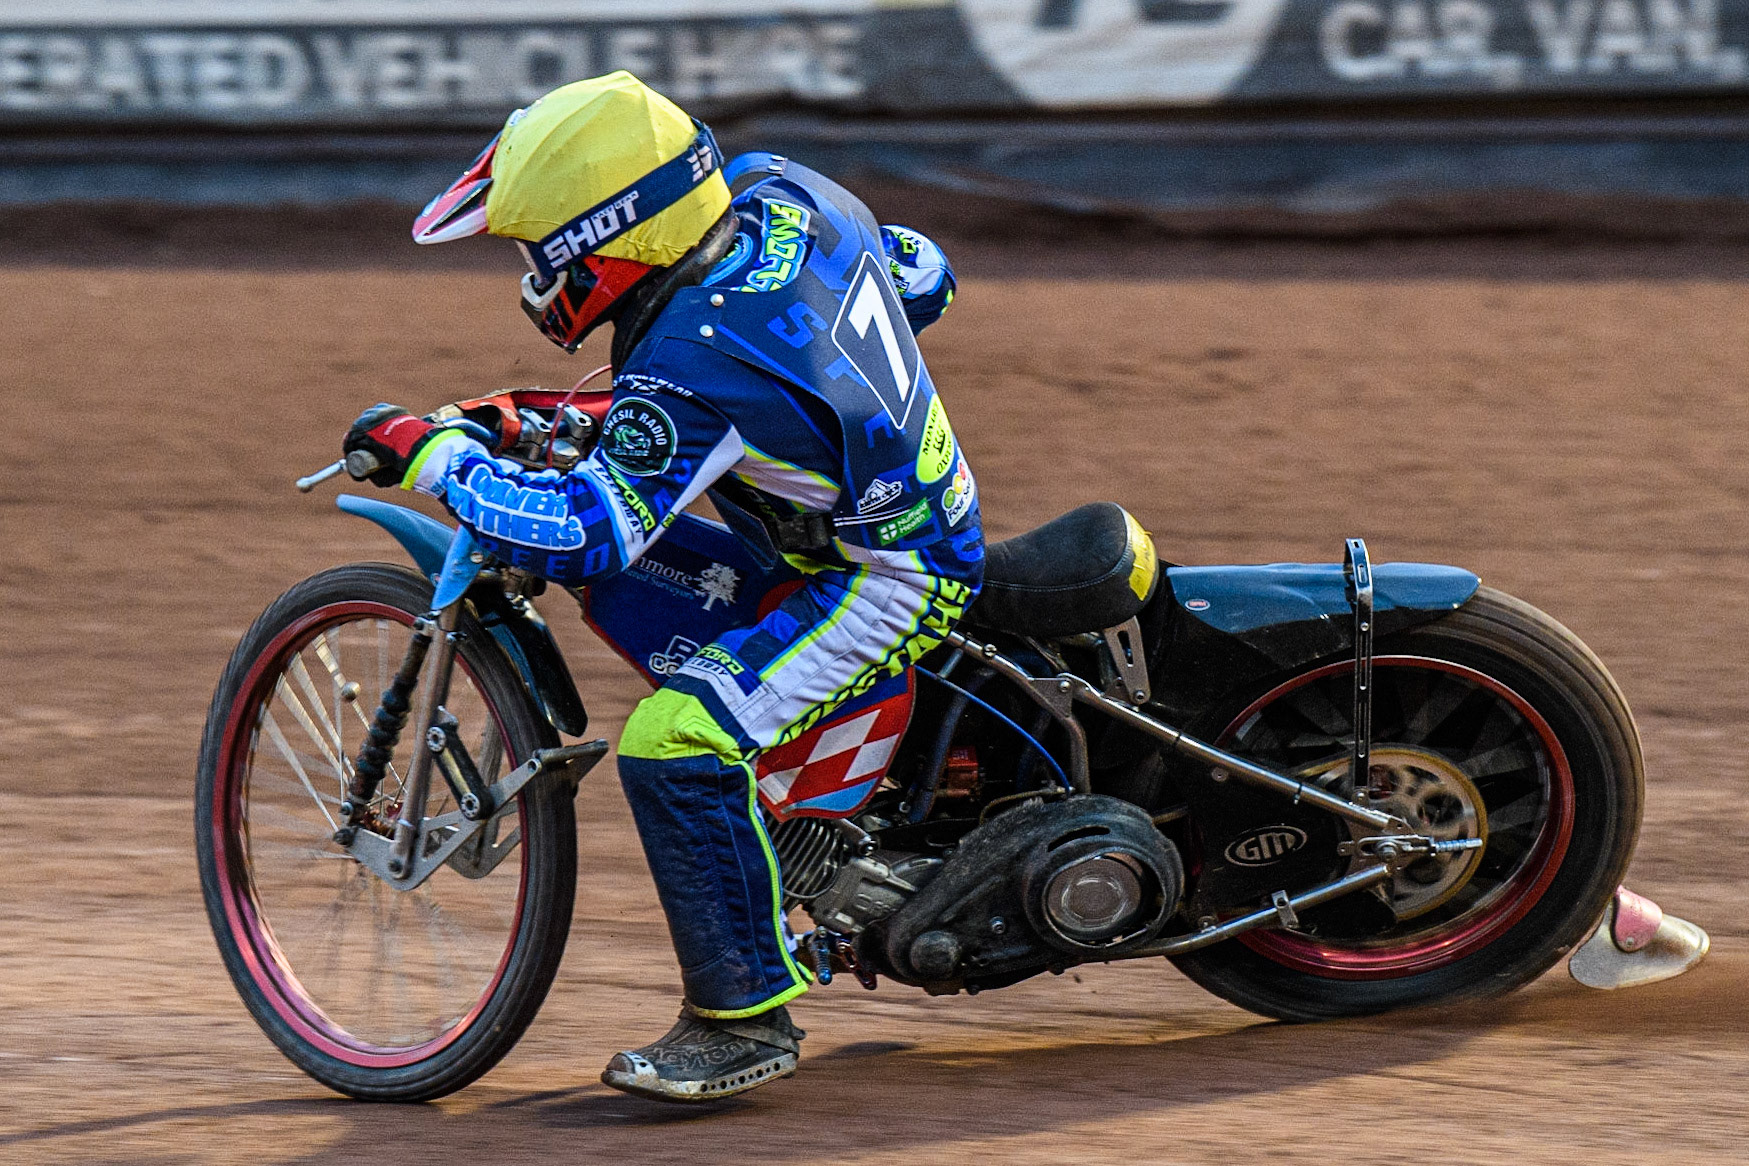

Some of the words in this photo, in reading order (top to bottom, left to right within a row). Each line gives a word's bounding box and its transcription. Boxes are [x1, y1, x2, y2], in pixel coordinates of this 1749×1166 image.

[543, 190, 640, 269] SHOT
[848, 271, 911, 402] 7
[639, 412, 667, 446] RADIO
[899, 513, 926, 534] Health
